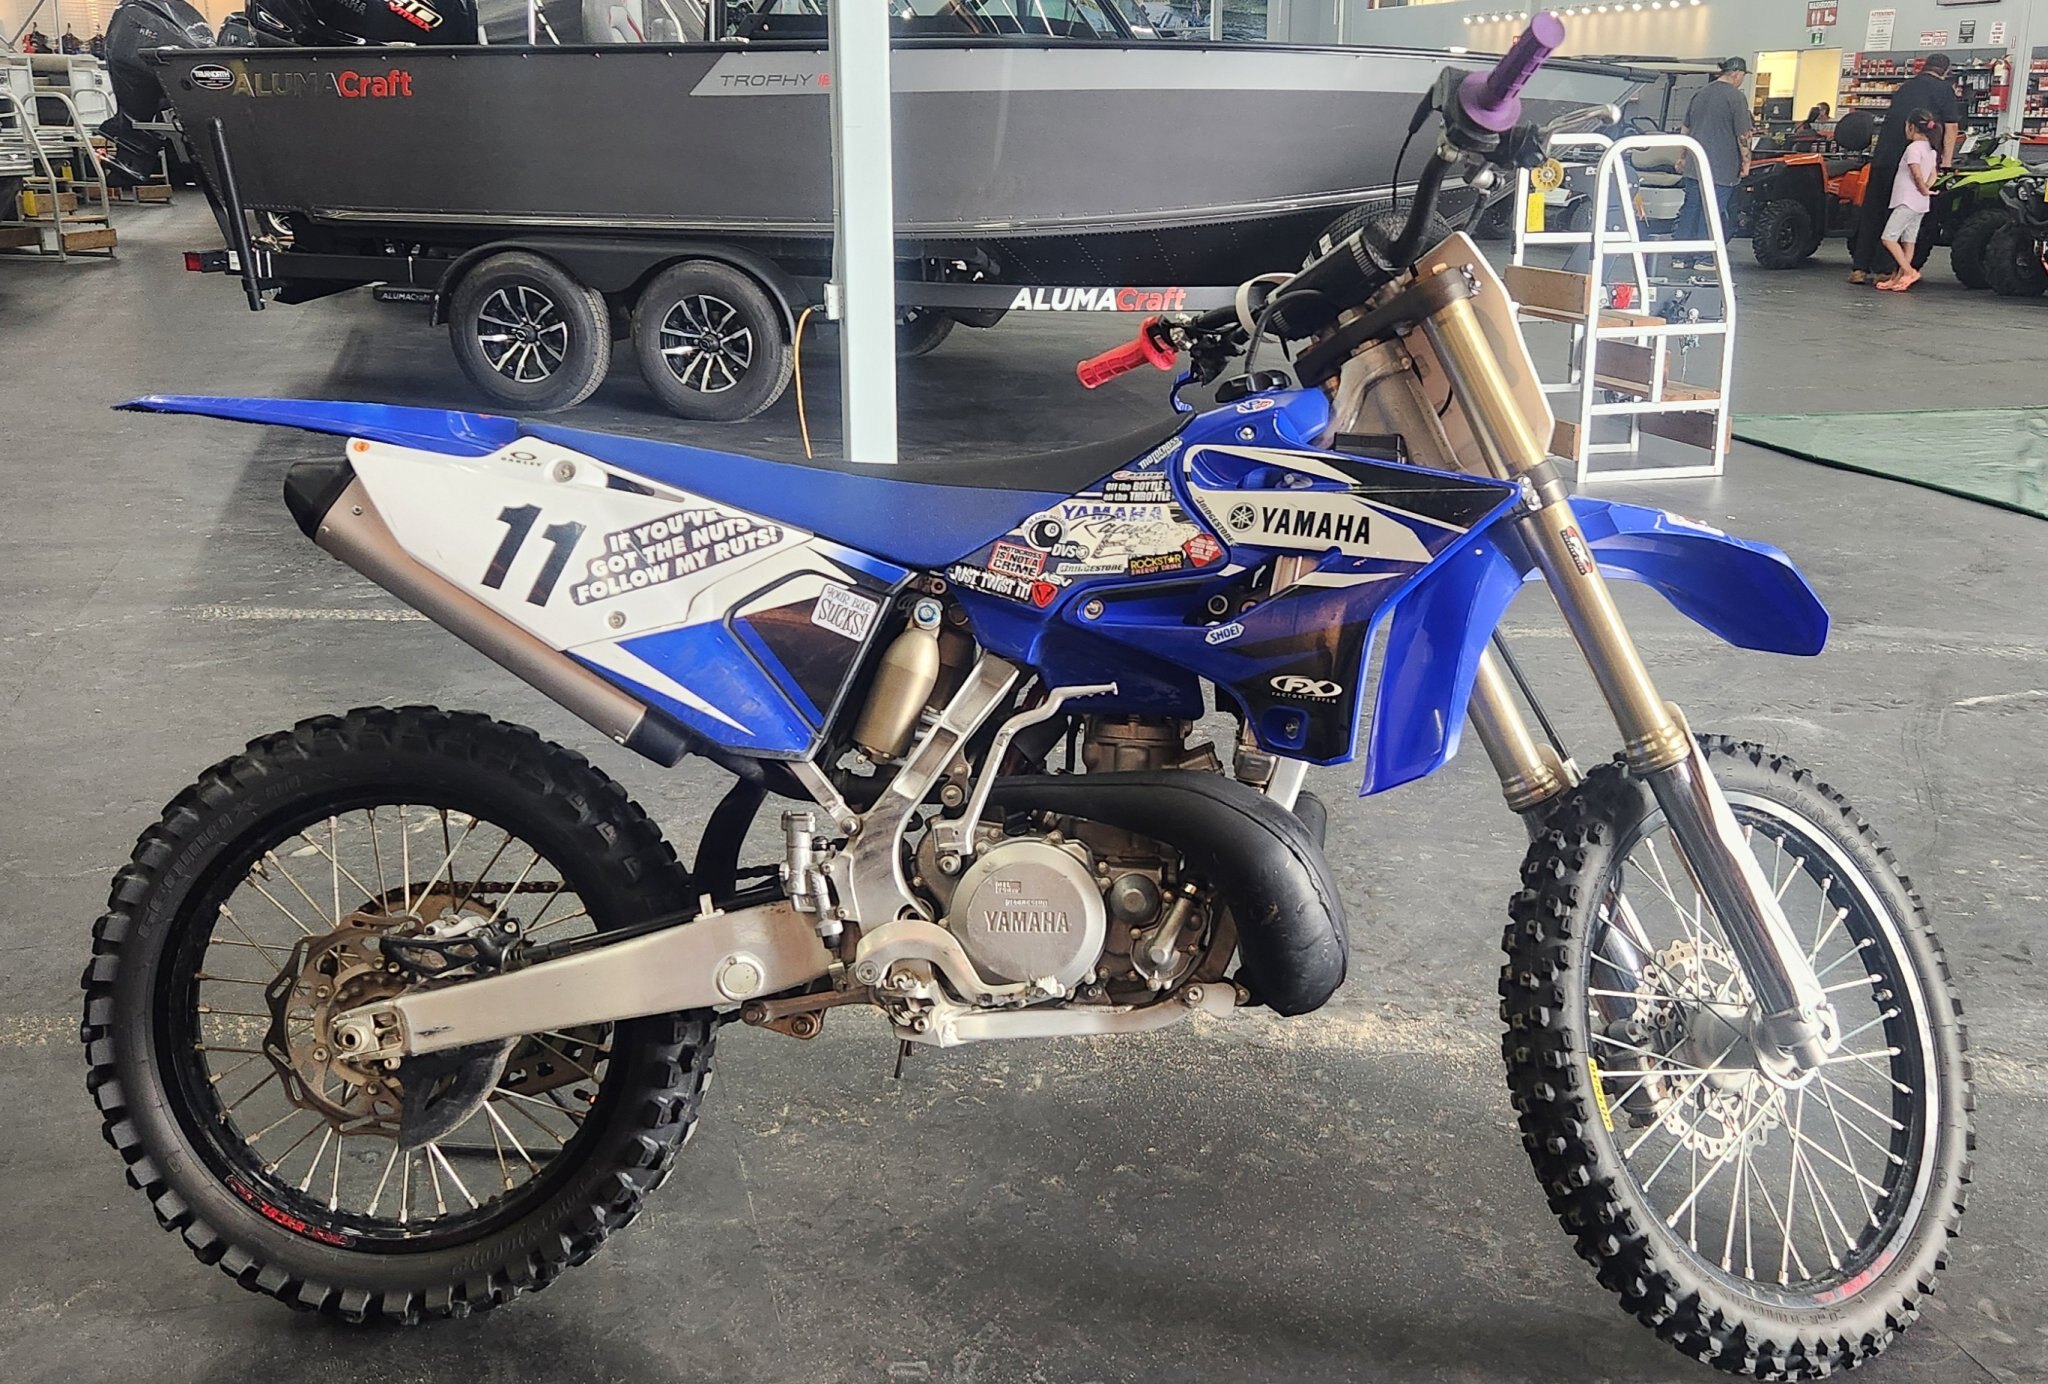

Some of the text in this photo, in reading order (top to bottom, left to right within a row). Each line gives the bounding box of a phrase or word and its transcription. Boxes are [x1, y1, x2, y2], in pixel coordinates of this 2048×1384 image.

[720, 73, 813, 87] TROPHY
[1009, 287, 1187, 311] ALUMACraft
[1132, 481, 1164, 491] BOTTLE
[1114, 492, 1128, 501] the
[1129, 491, 1172, 502] THROTTLE
[1062, 505, 1161, 521] YAMAHA
[1195, 496, 1234, 544] BRIDGESTONE
[1049, 525, 1057, 534] 8
[1263, 506, 1370, 545] YAMAHA
[591, 518, 751, 577] GOT THE NUTS
[609, 532, 631, 552] IF
[999, 544, 1042, 559] MOTOCROSS
[1051, 543, 1077, 558] DVS
[481, 503, 587, 607] 11
[996, 550, 1039, 567] IS NOT A
[577, 526, 778, 605] FOLLOW MY RUTS!
[993, 558, 1037, 577] CRIME
[1131, 563, 1182, 576] ENERGY DRINK
[950, 565, 980, 584] JUST
[981, 570, 1016, 595] TWIST
[1015, 581, 1033, 600] IT!
[827, 586, 875, 614] YOUR BIKE
[817, 598, 869, 638] SUCKS!
[1210, 624, 1241, 643] SHOEI
[984, 911, 1069, 934] YAMAHA
